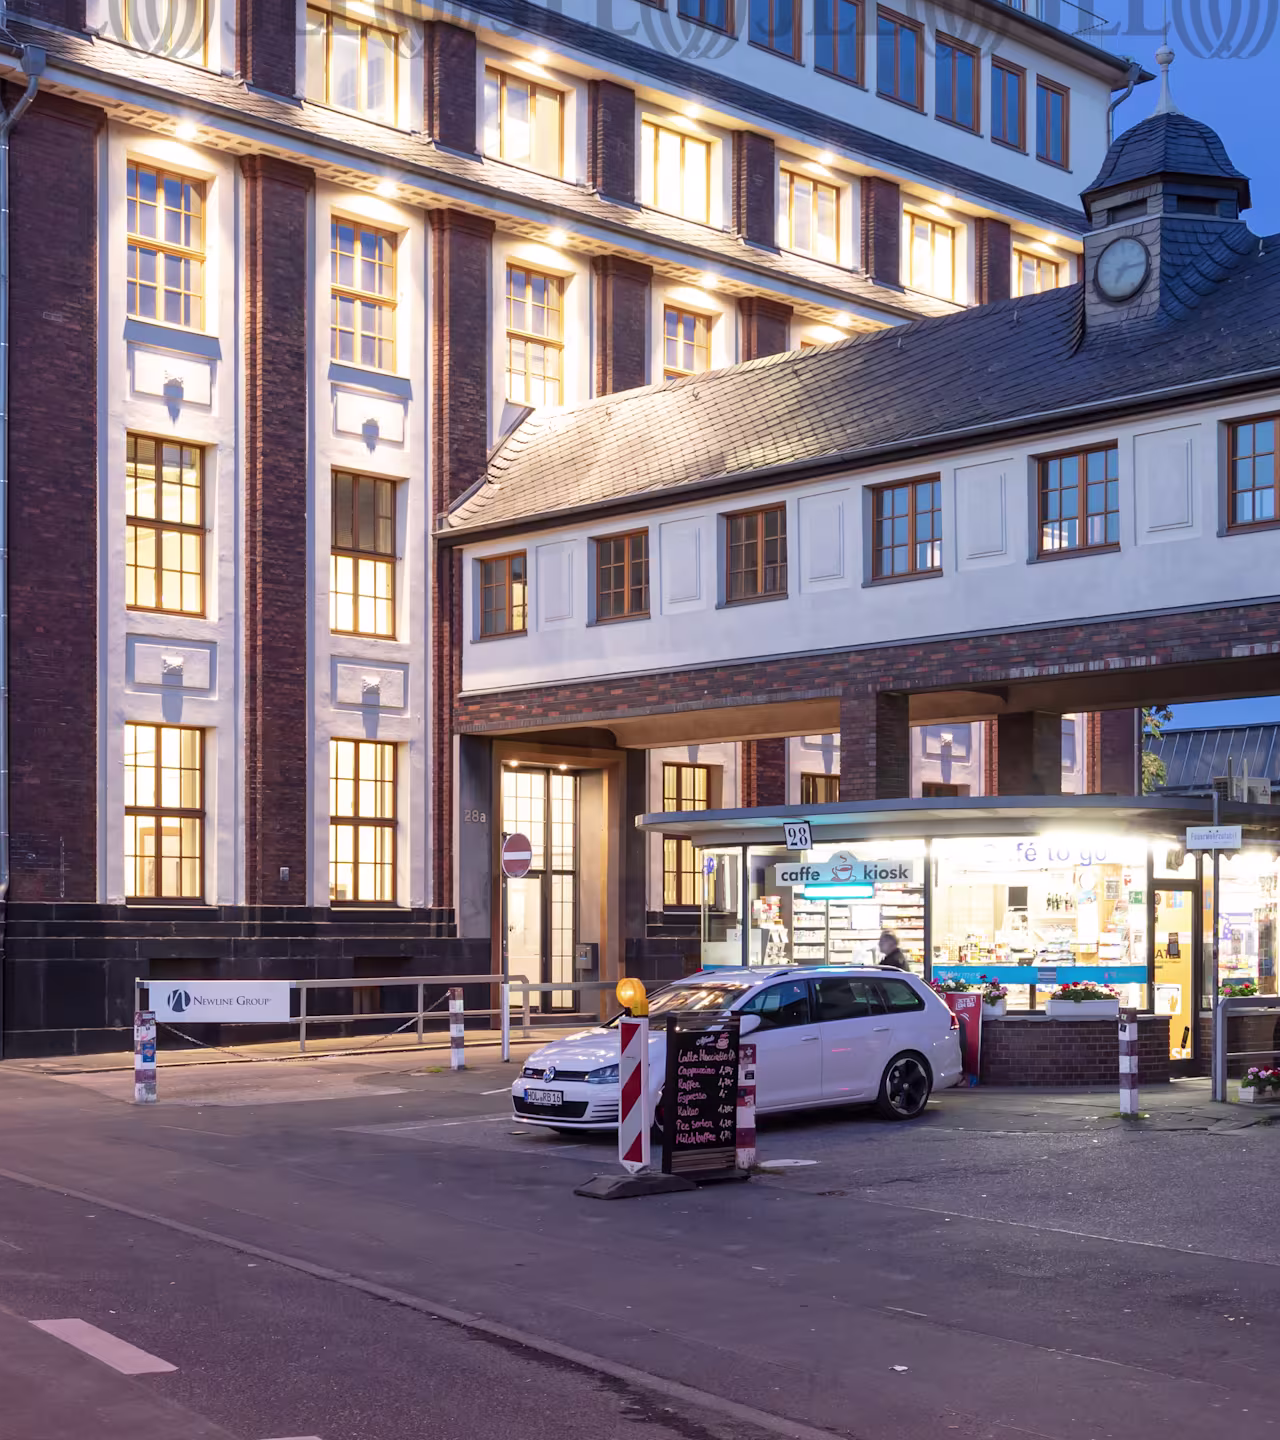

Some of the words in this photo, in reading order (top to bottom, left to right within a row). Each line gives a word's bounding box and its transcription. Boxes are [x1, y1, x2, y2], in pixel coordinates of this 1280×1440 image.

[464, 809, 486, 823] 28a
[788, 827, 808, 846] 28
[781, 867, 820, 881] caffe
[863, 864, 908, 880] kiosk
[552, 1094, 560, 1102] 16
